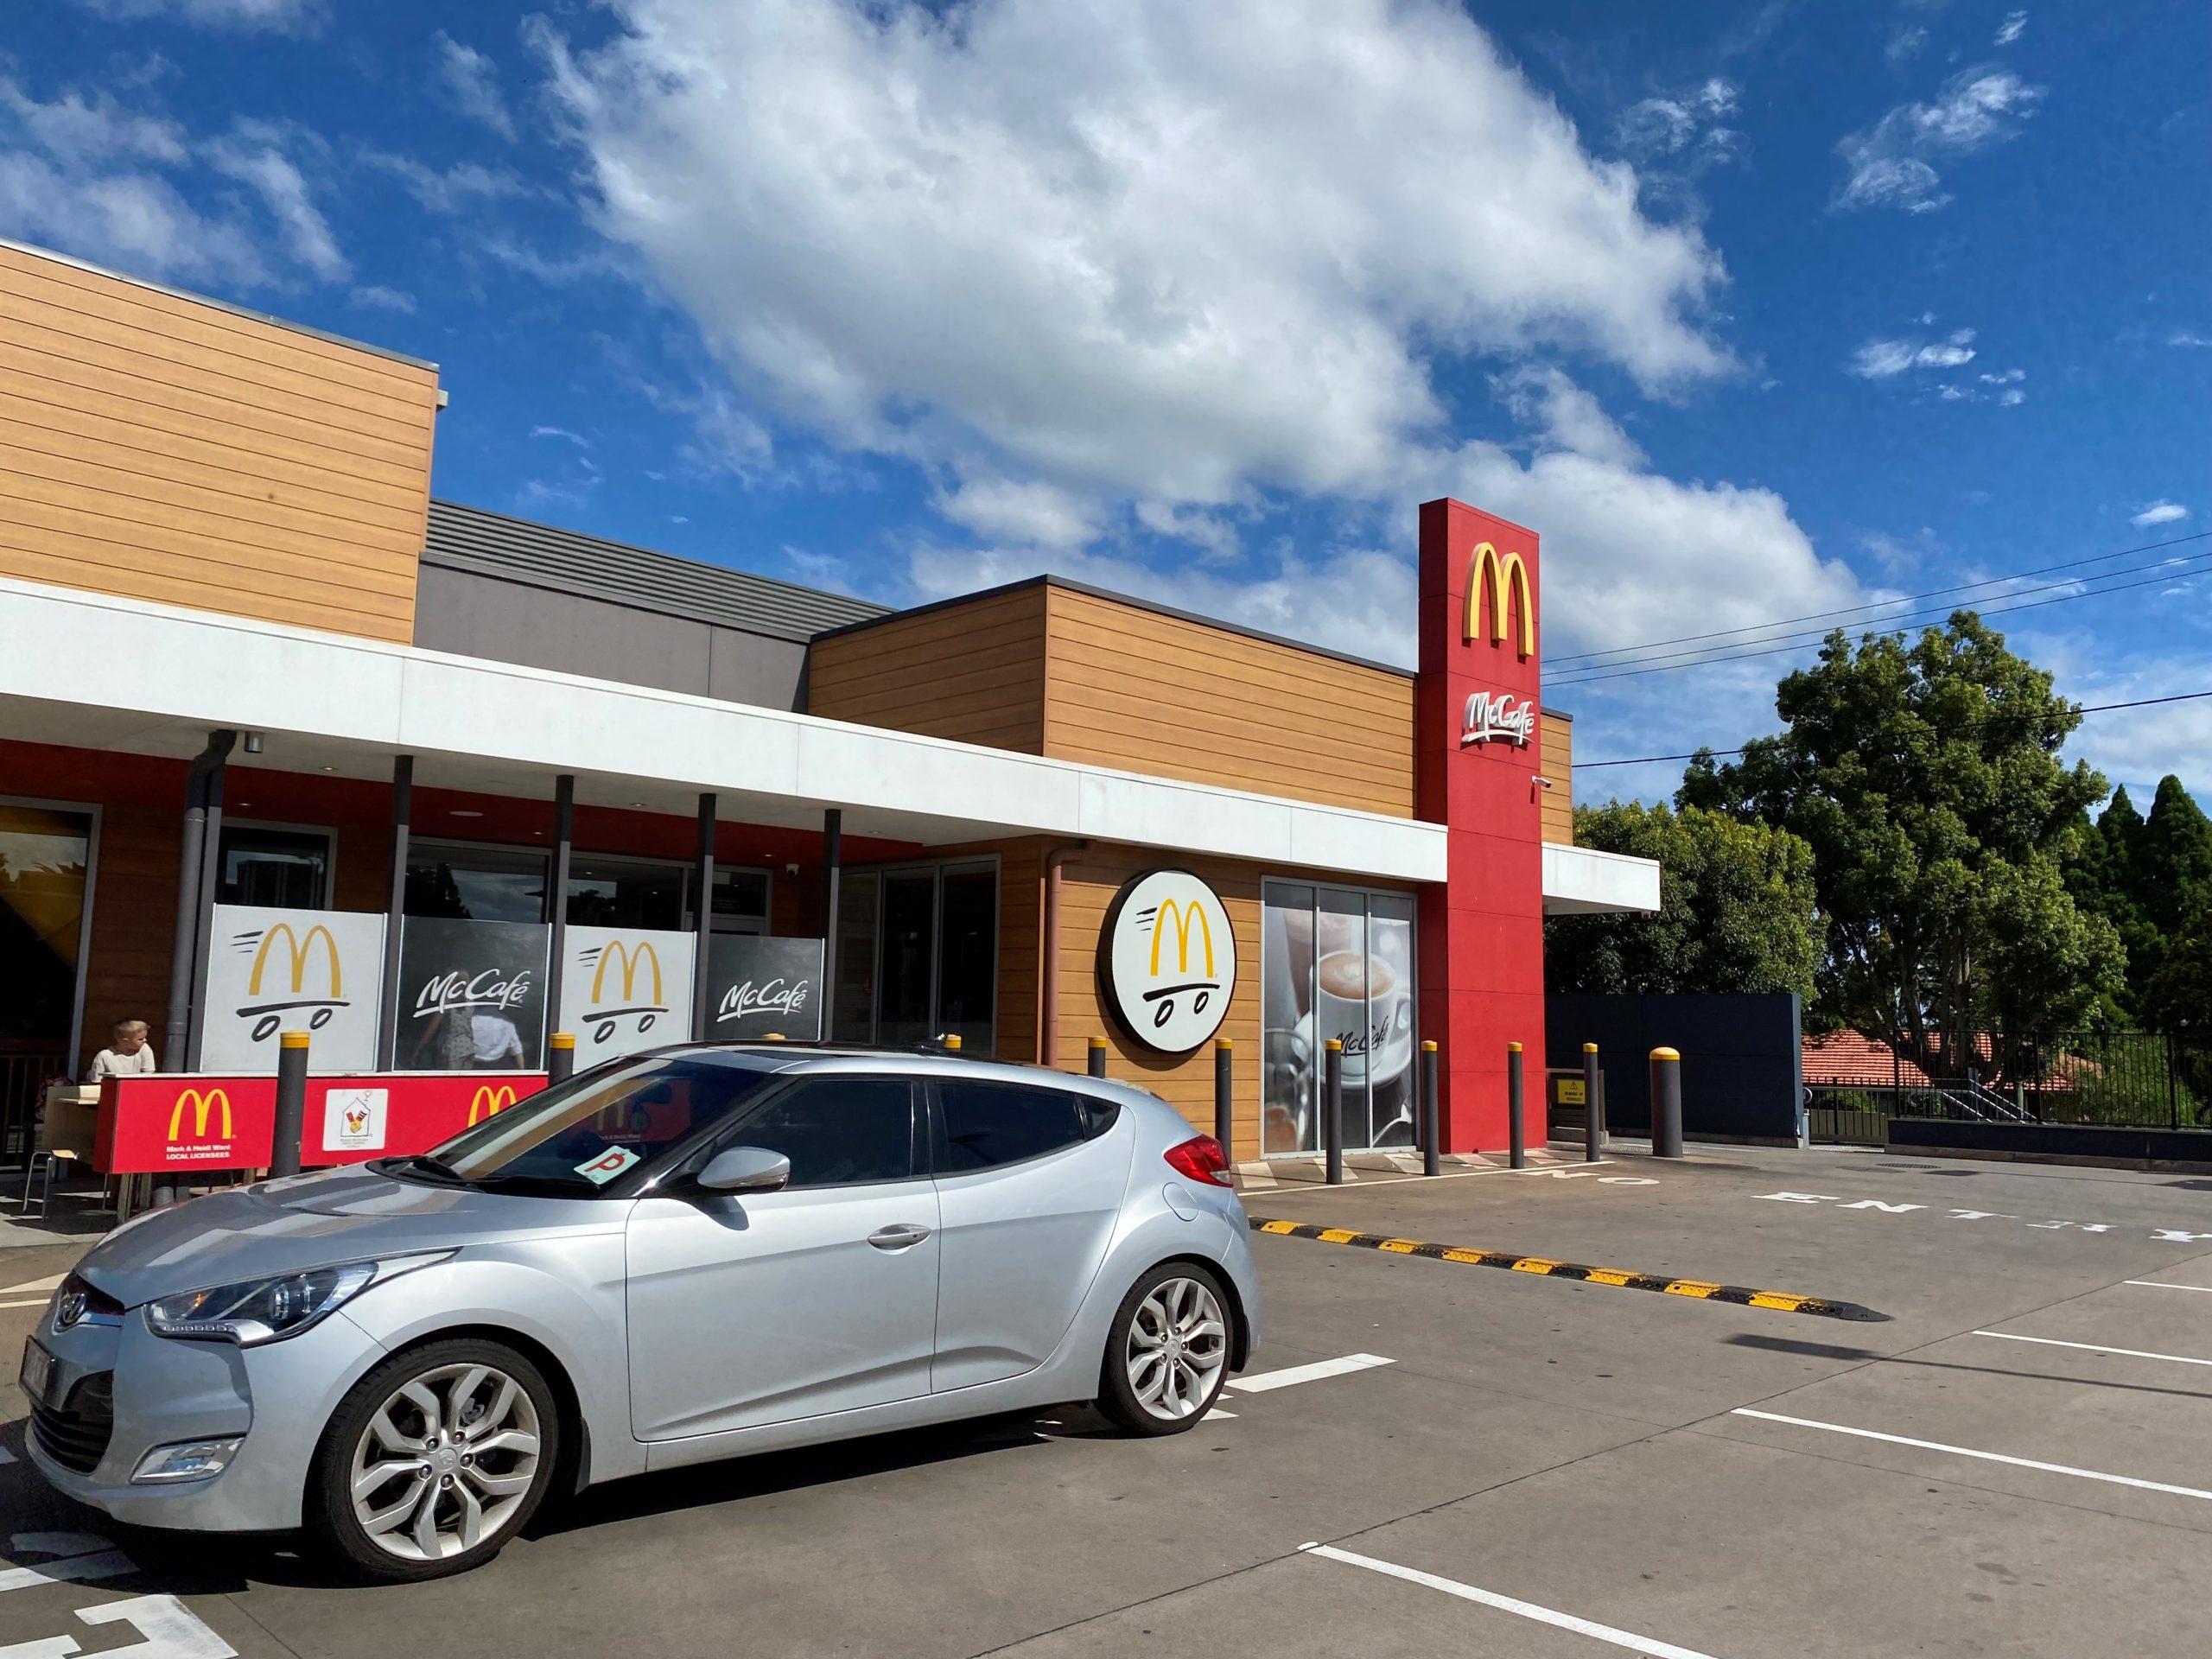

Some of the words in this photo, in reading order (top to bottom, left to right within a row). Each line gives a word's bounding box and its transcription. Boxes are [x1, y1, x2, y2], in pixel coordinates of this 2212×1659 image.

[415, 969, 531, 1015] McCafé
[718, 978, 808, 1020] McCafé
[584, 1154, 625, 1173] P
